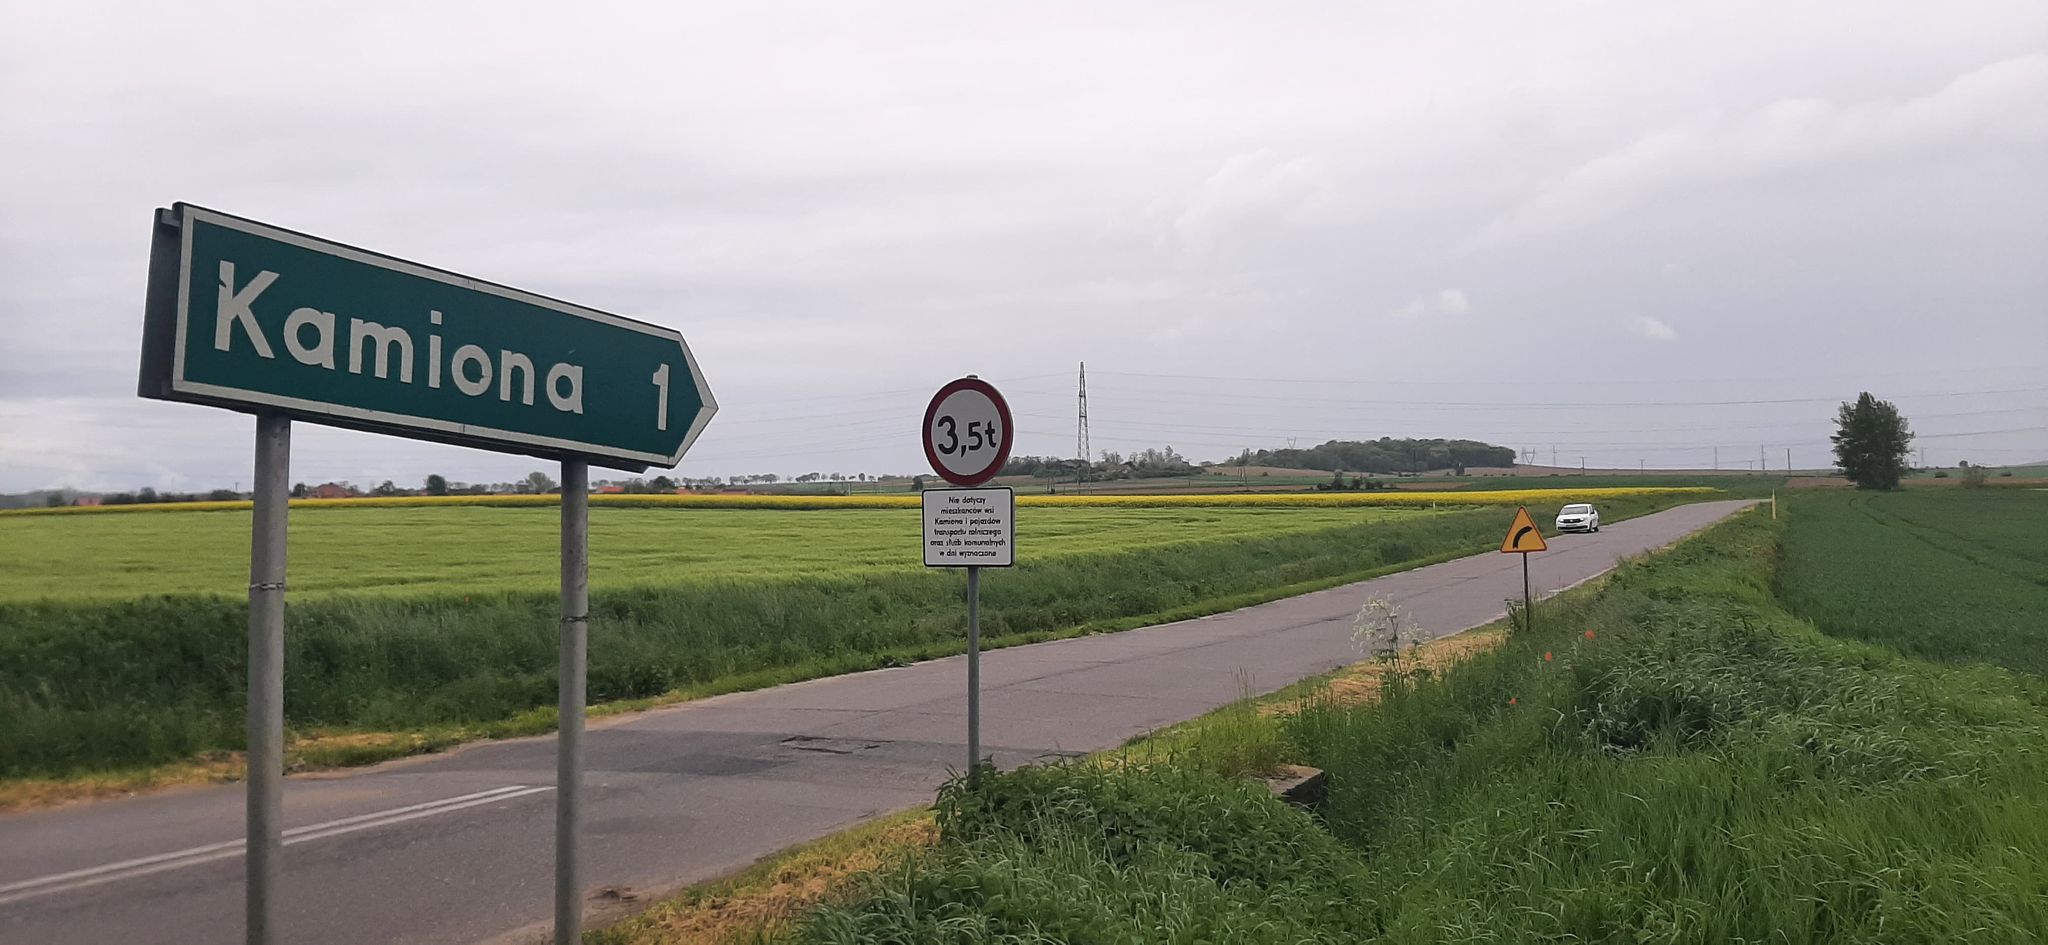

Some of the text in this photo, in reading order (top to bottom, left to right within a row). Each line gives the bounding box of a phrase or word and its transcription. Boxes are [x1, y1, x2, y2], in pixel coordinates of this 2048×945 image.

[213, 260, 670, 431] Kamiona 1
[937, 415, 997, 458] 3,5t
[948, 496, 986, 505] Nie dotyczy
[934, 517, 963, 525] Kamiona
[934, 527, 1002, 537] transportu rolniczego
[964, 538, 1006, 547] komunalnych
